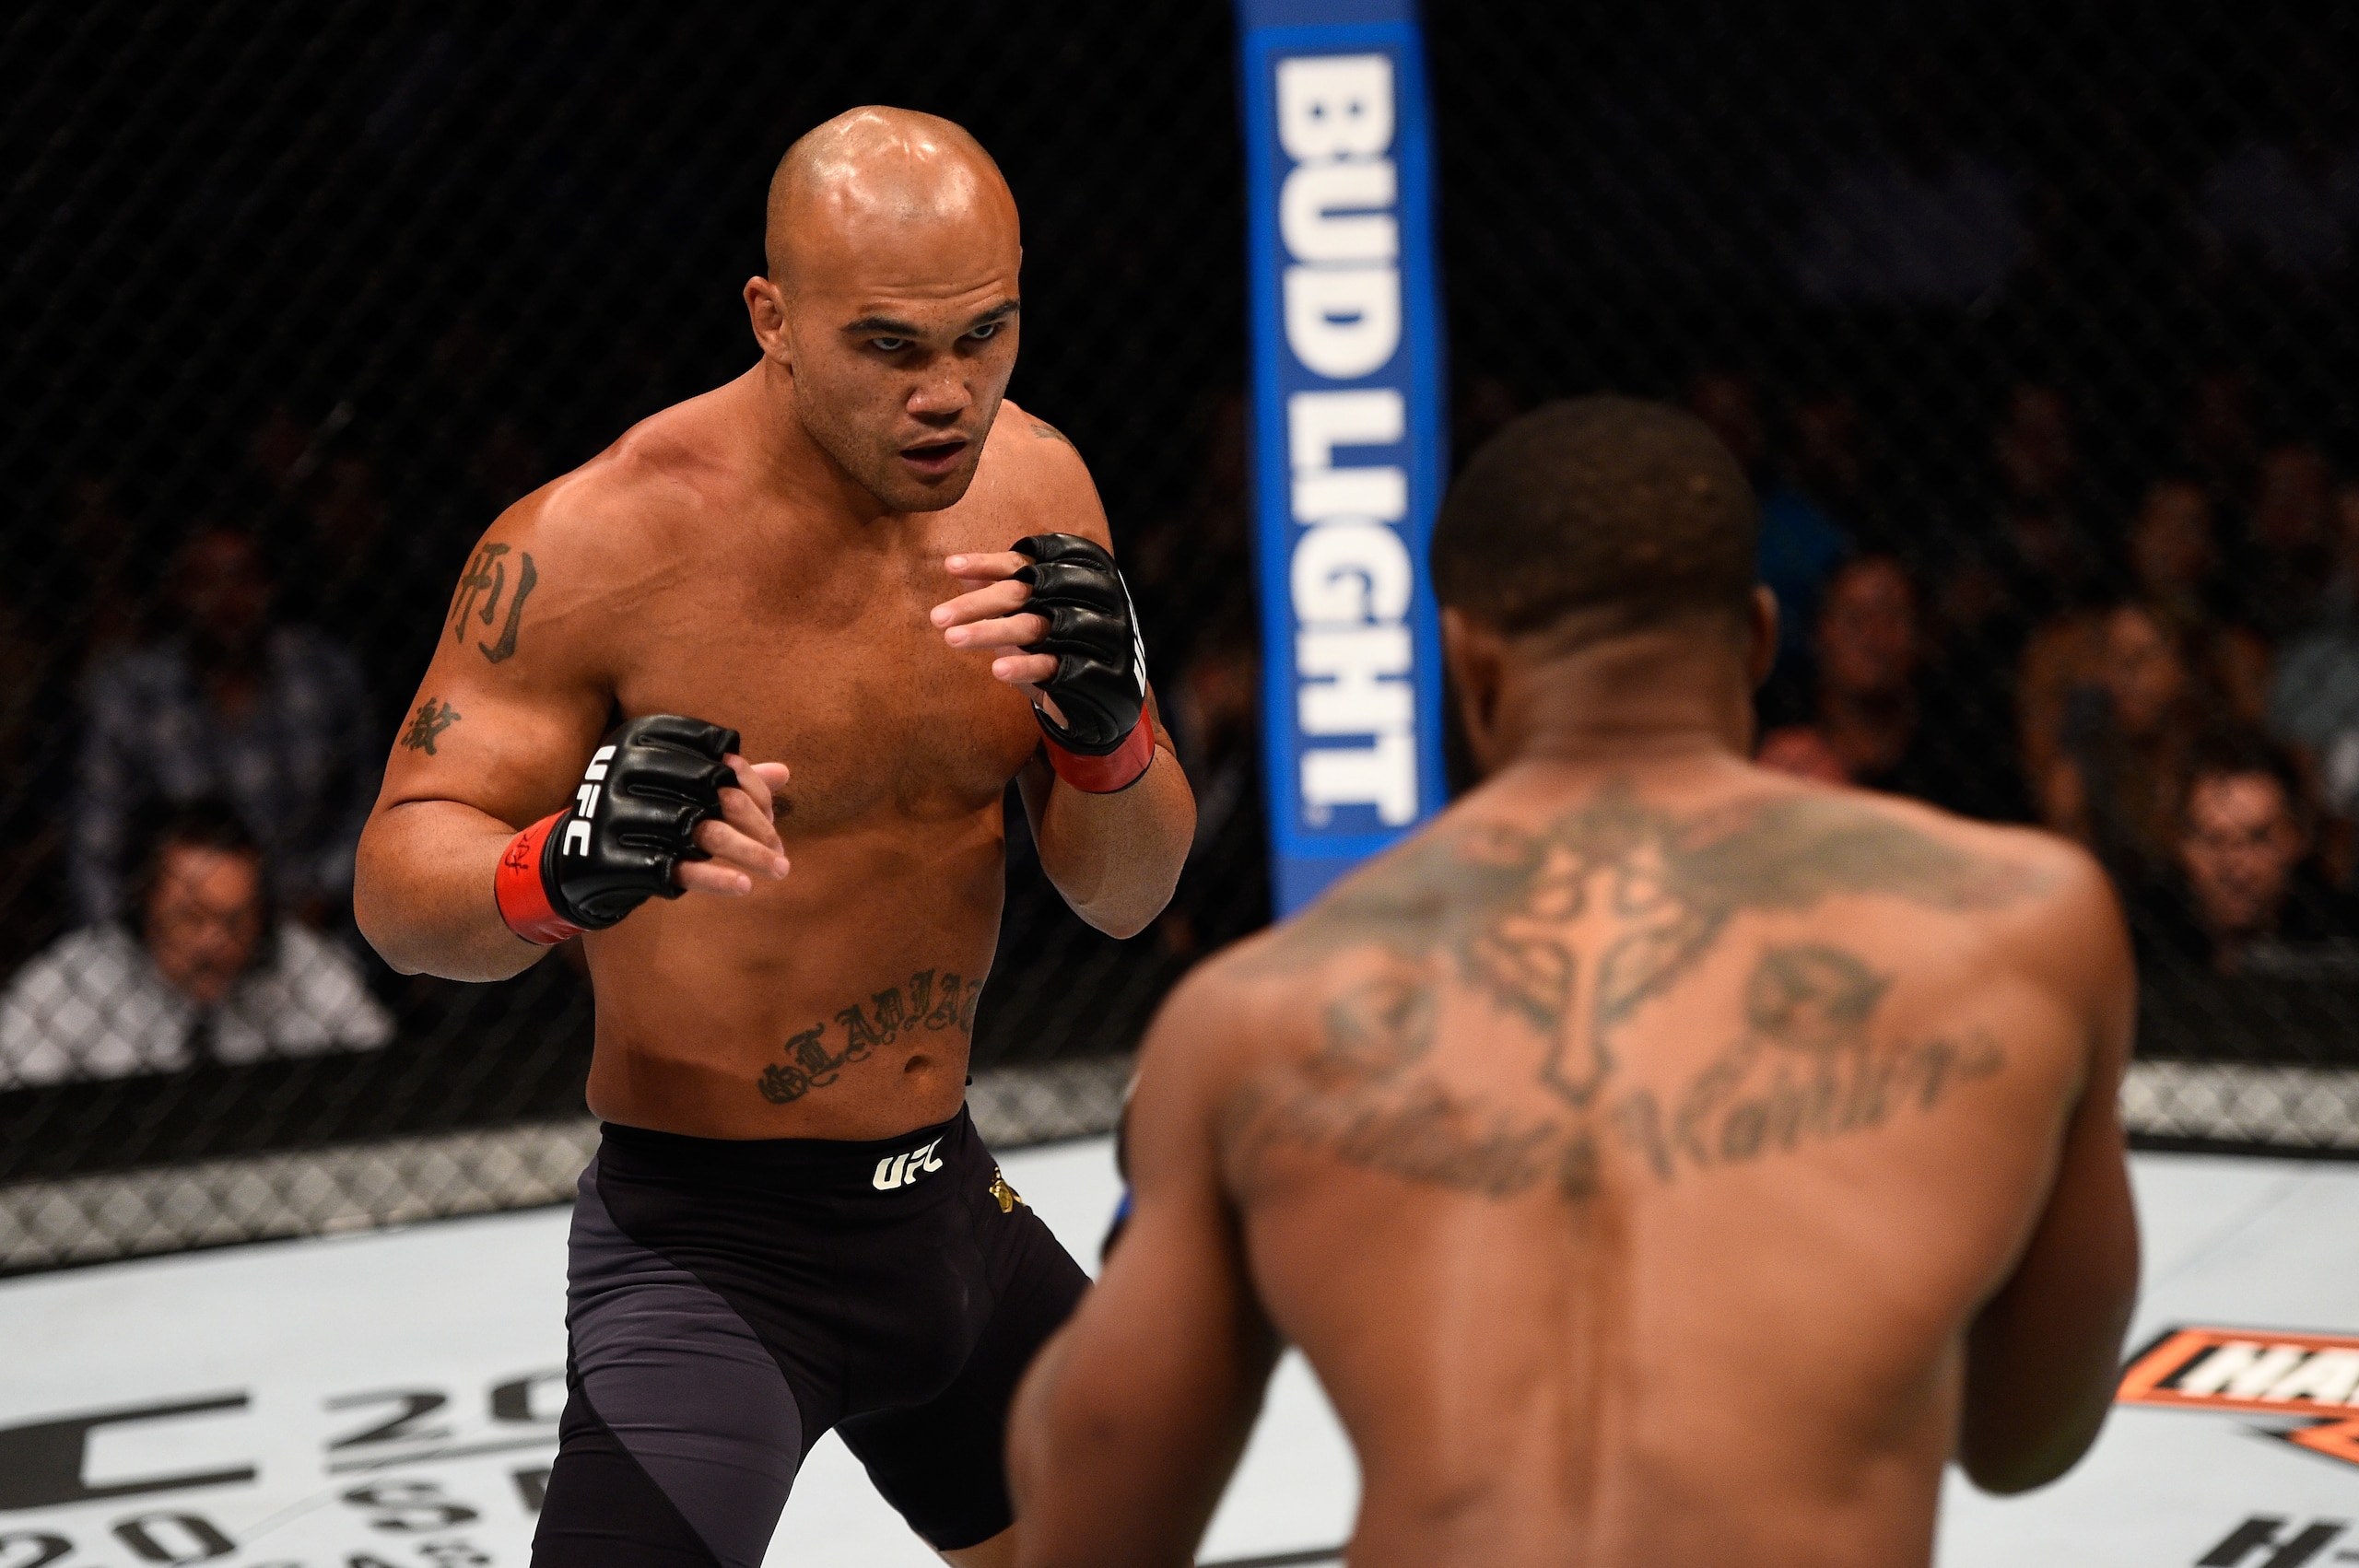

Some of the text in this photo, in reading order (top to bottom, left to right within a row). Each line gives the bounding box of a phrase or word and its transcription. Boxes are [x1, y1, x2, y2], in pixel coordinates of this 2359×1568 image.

[1274, 53, 1417, 826] BUD LIGHT
[561, 744, 616, 858] UFC
[872, 1136, 944, 1191] UFC
[2175, 1340, 2359, 1409] HA
